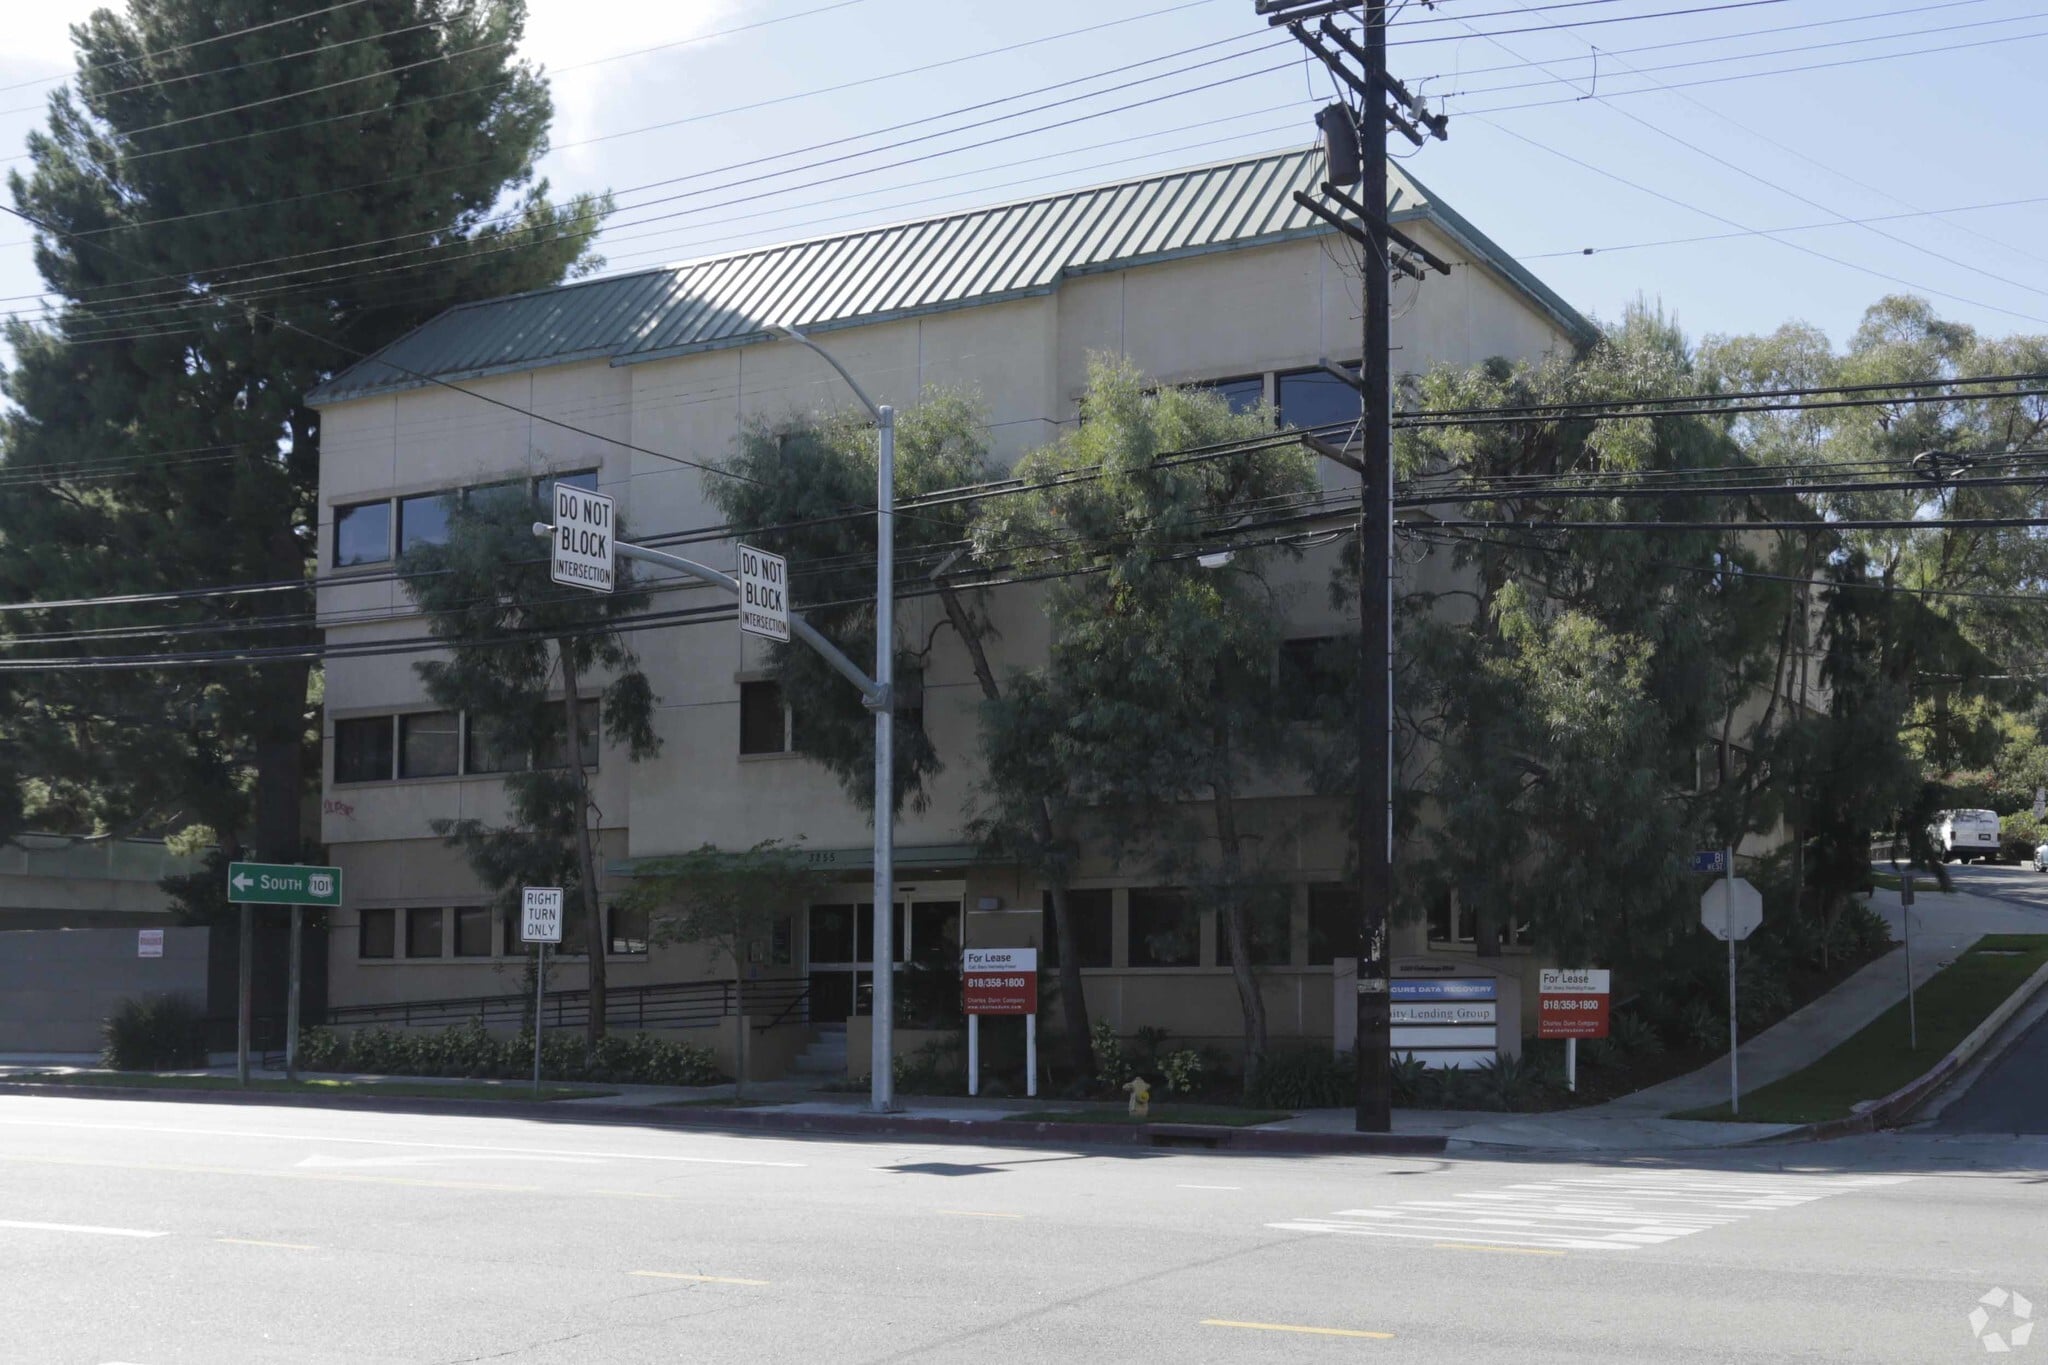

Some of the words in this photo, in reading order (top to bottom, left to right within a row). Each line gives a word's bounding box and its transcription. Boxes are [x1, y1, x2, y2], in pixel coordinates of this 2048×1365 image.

[560, 493, 578, 520] DO
[583, 499, 610, 528] NOT
[562, 526, 607, 559] BLOCK
[556, 559, 611, 584] INTERSECTION
[743, 553, 758, 577] DO
[762, 559, 782, 585] NOT
[746, 582, 783, 612] BLOCK
[743, 611, 787, 634] INTERSECTION
[313, 880, 329, 892] 101
[527, 892, 558, 905] RIGHT
[528, 908, 556, 920] TURN
[527, 923, 556, 936] ONLY
[968, 953, 983, 963] For
[985, 952, 1012, 963] Lease
[967, 977, 1025, 989] 818/358-1800
[1543, 973, 1559, 984] For
[1562, 973, 1590, 984] Lease
[1418, 985, 1442, 994] DATA
[1443, 984, 1493, 994] RECOVERY
[1543, 1000, 1599, 1011] 818/358-1800
[1390, 1010, 1407, 1021] ity
[1410, 1008, 1454, 1020] Lending
[1456, 1007, 1491, 1019] Group
